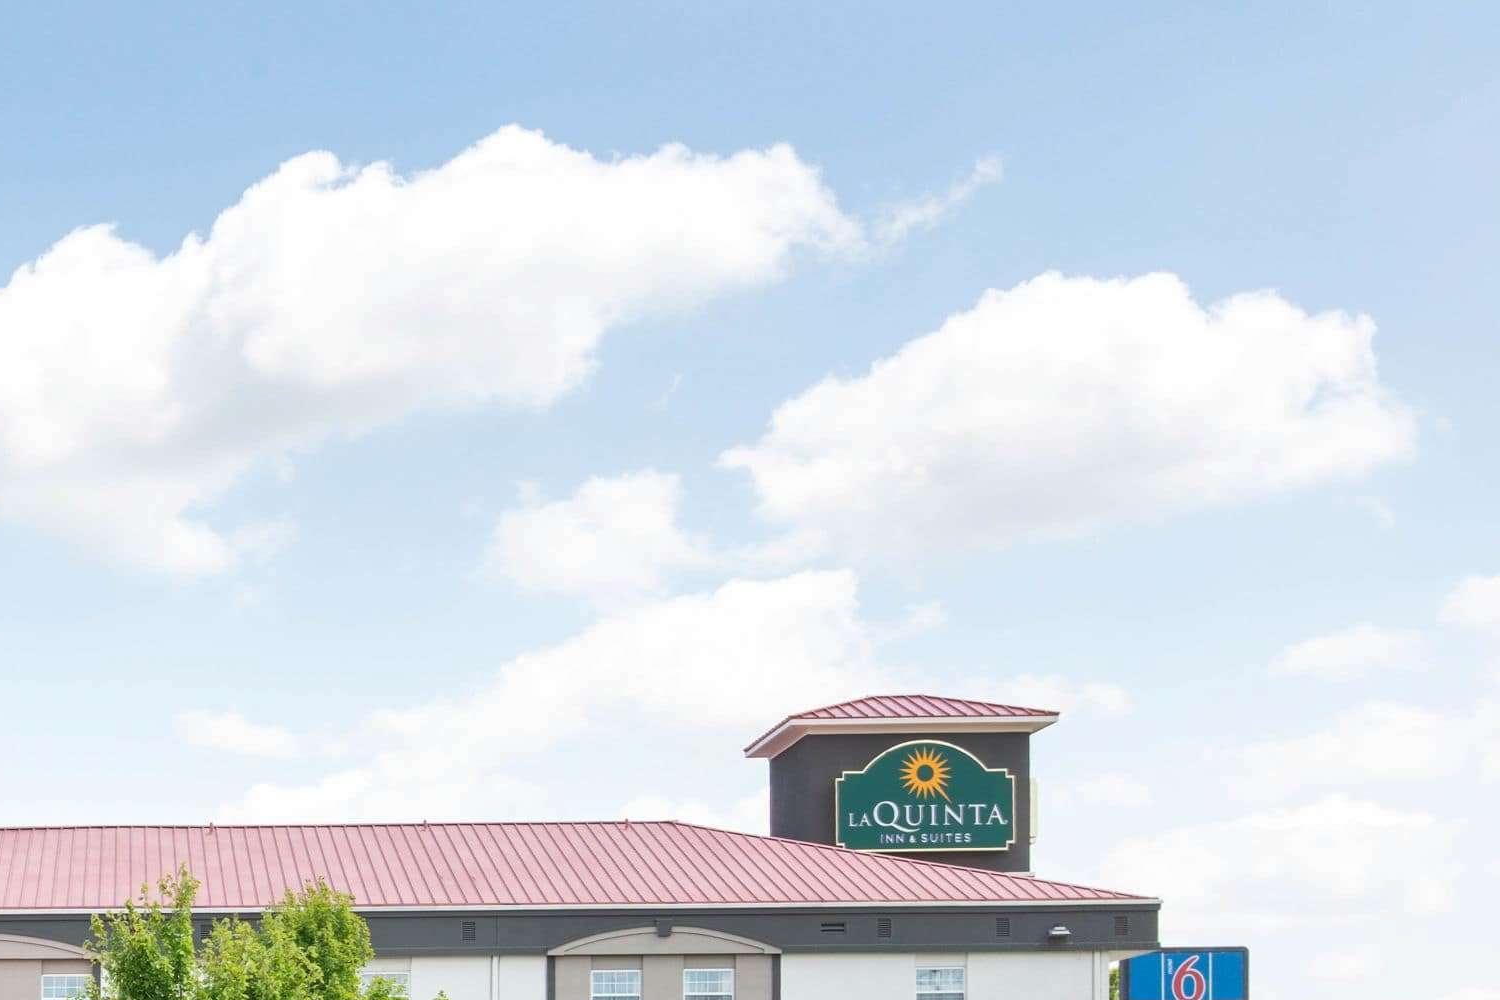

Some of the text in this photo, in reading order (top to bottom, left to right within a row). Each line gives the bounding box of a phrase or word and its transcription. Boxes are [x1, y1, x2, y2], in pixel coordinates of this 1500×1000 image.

[872, 800, 1009, 833] QUINTA
[880, 832, 973, 843] INN & SUITES
